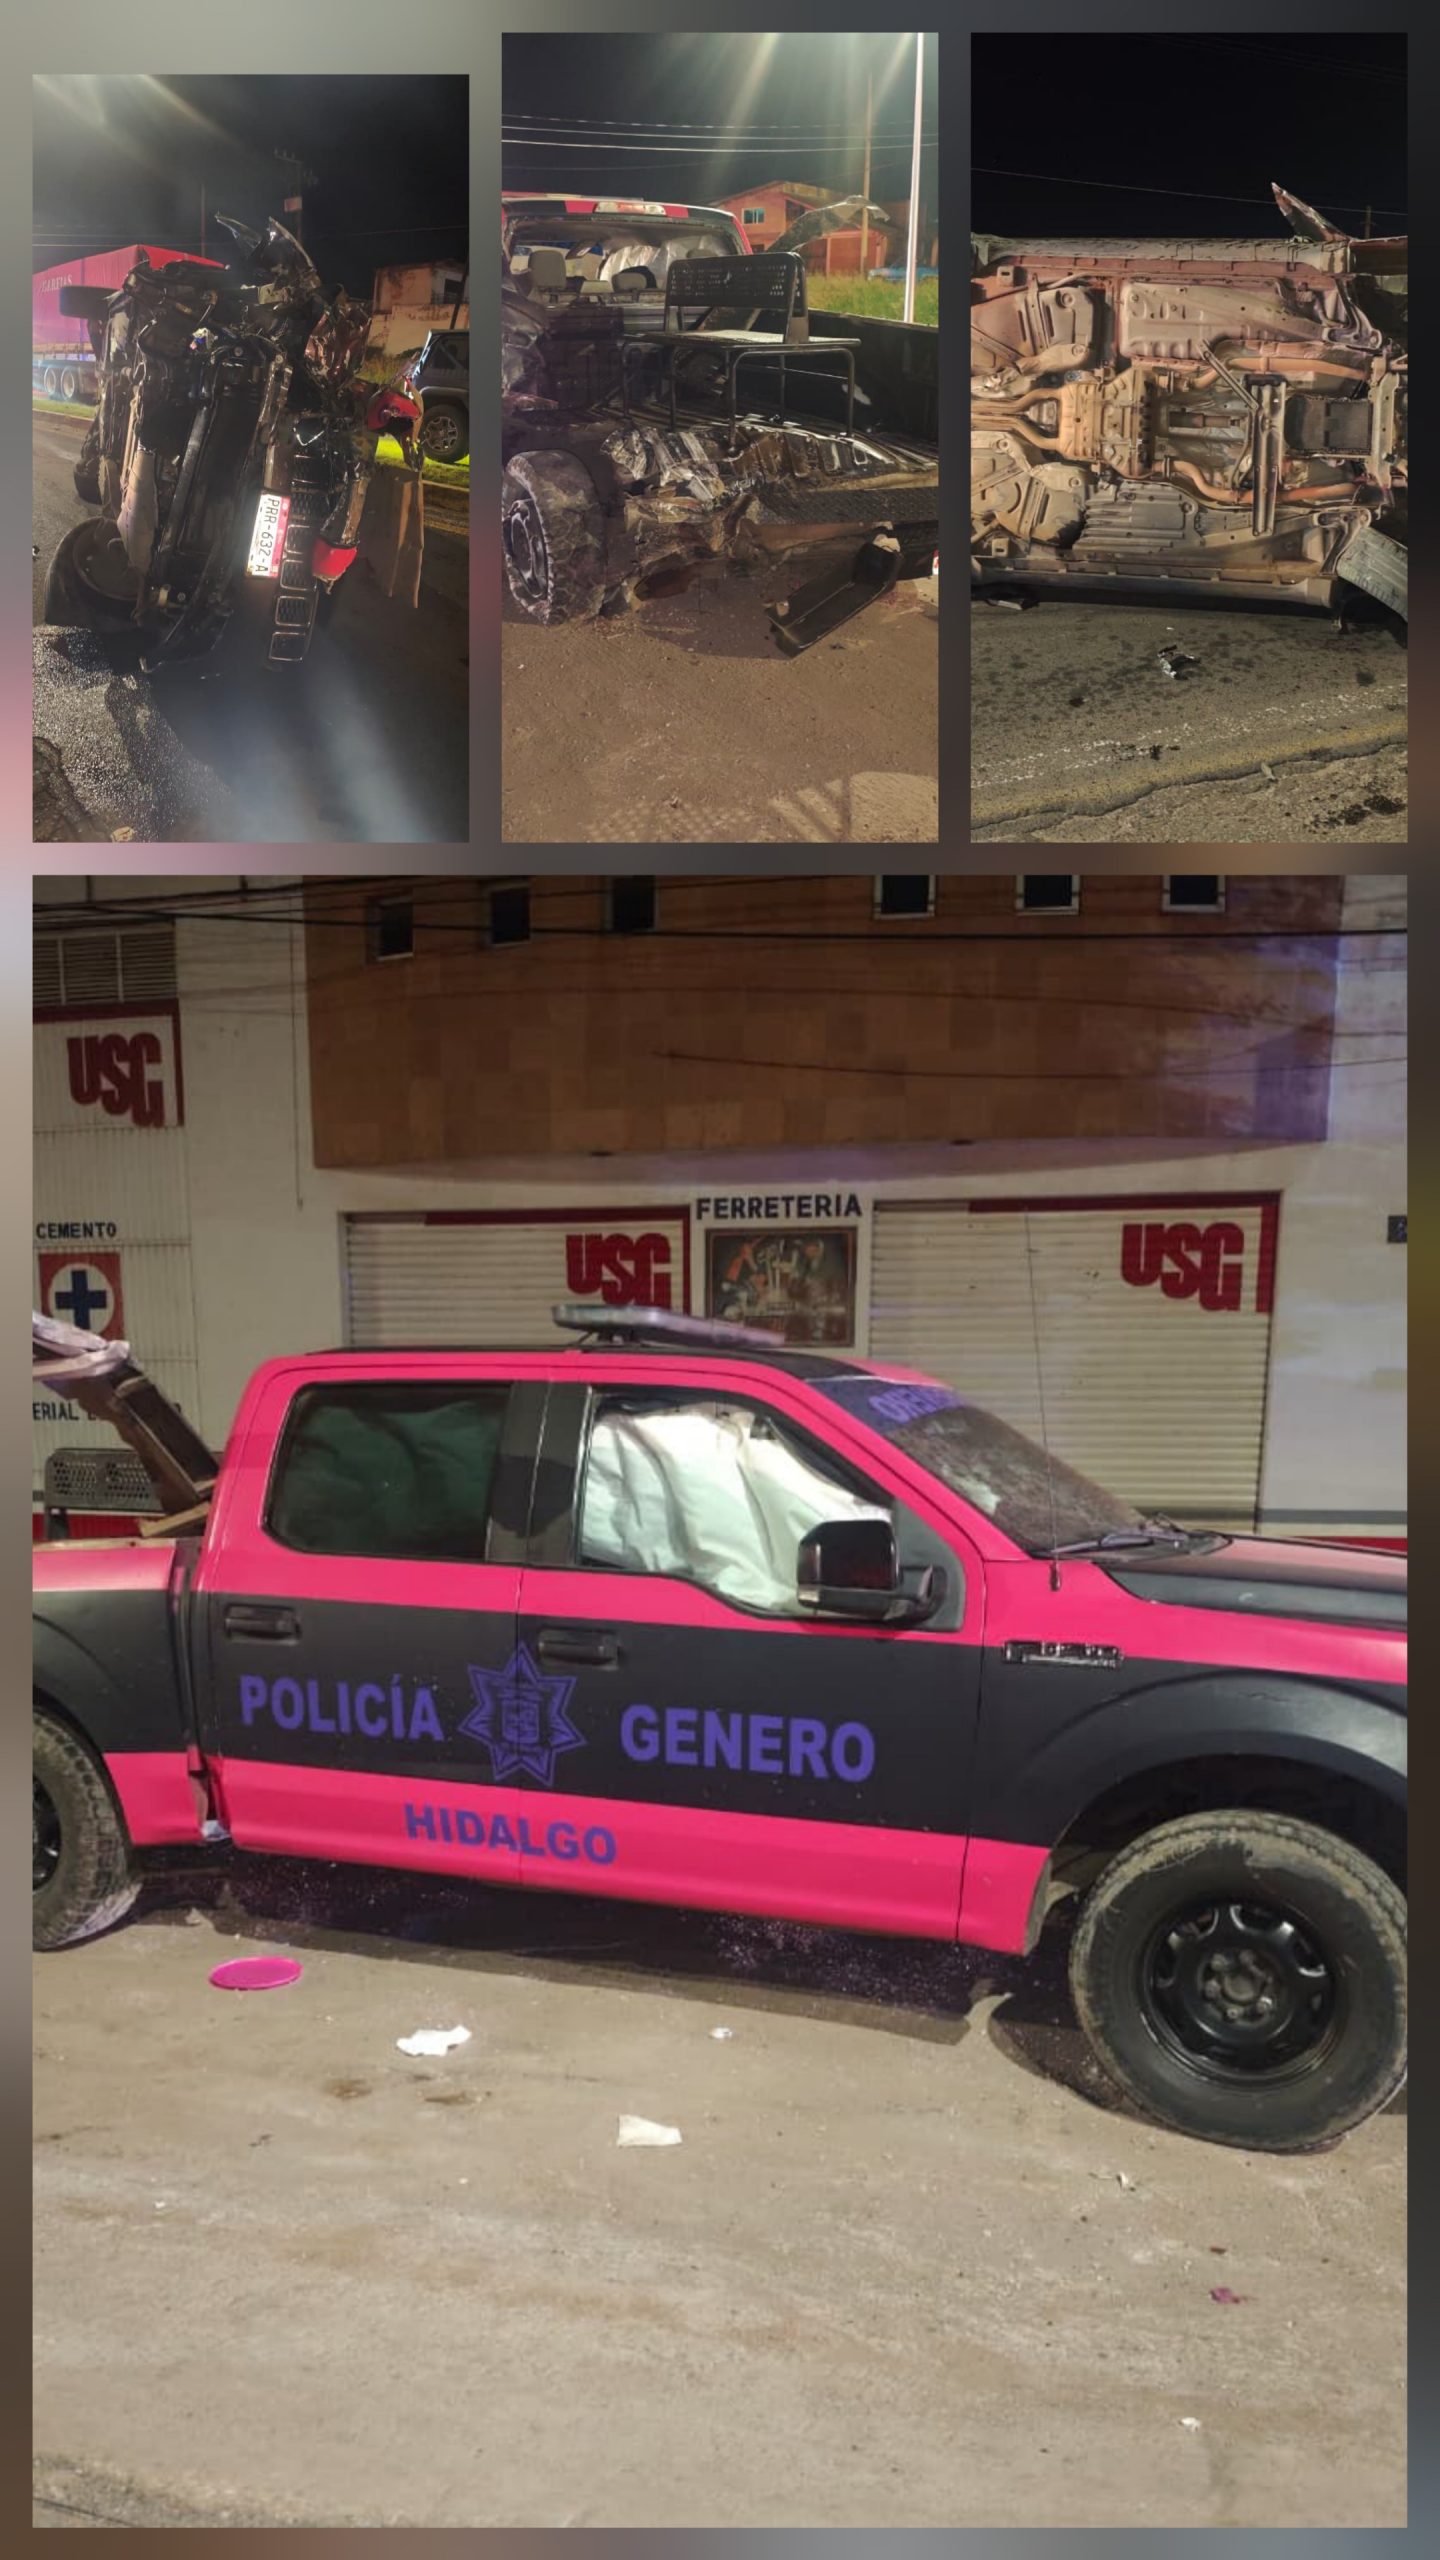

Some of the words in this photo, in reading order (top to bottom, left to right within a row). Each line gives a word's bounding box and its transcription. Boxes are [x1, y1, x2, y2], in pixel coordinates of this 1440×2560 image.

[255, 498, 281, 573] PRR-632-A
[66, 1032, 165, 1129] USG
[35, 1221, 118, 1240] CEMENTO
[695, 1193, 863, 1220] FERRETERIA
[565, 1232, 672, 1316] USG
[1121, 1221, 1246, 1312] USG
[239, 1673, 445, 1742] POLICÍA
[620, 1703, 876, 1783] GENERO
[404, 1803, 618, 1866] HIDALGO
